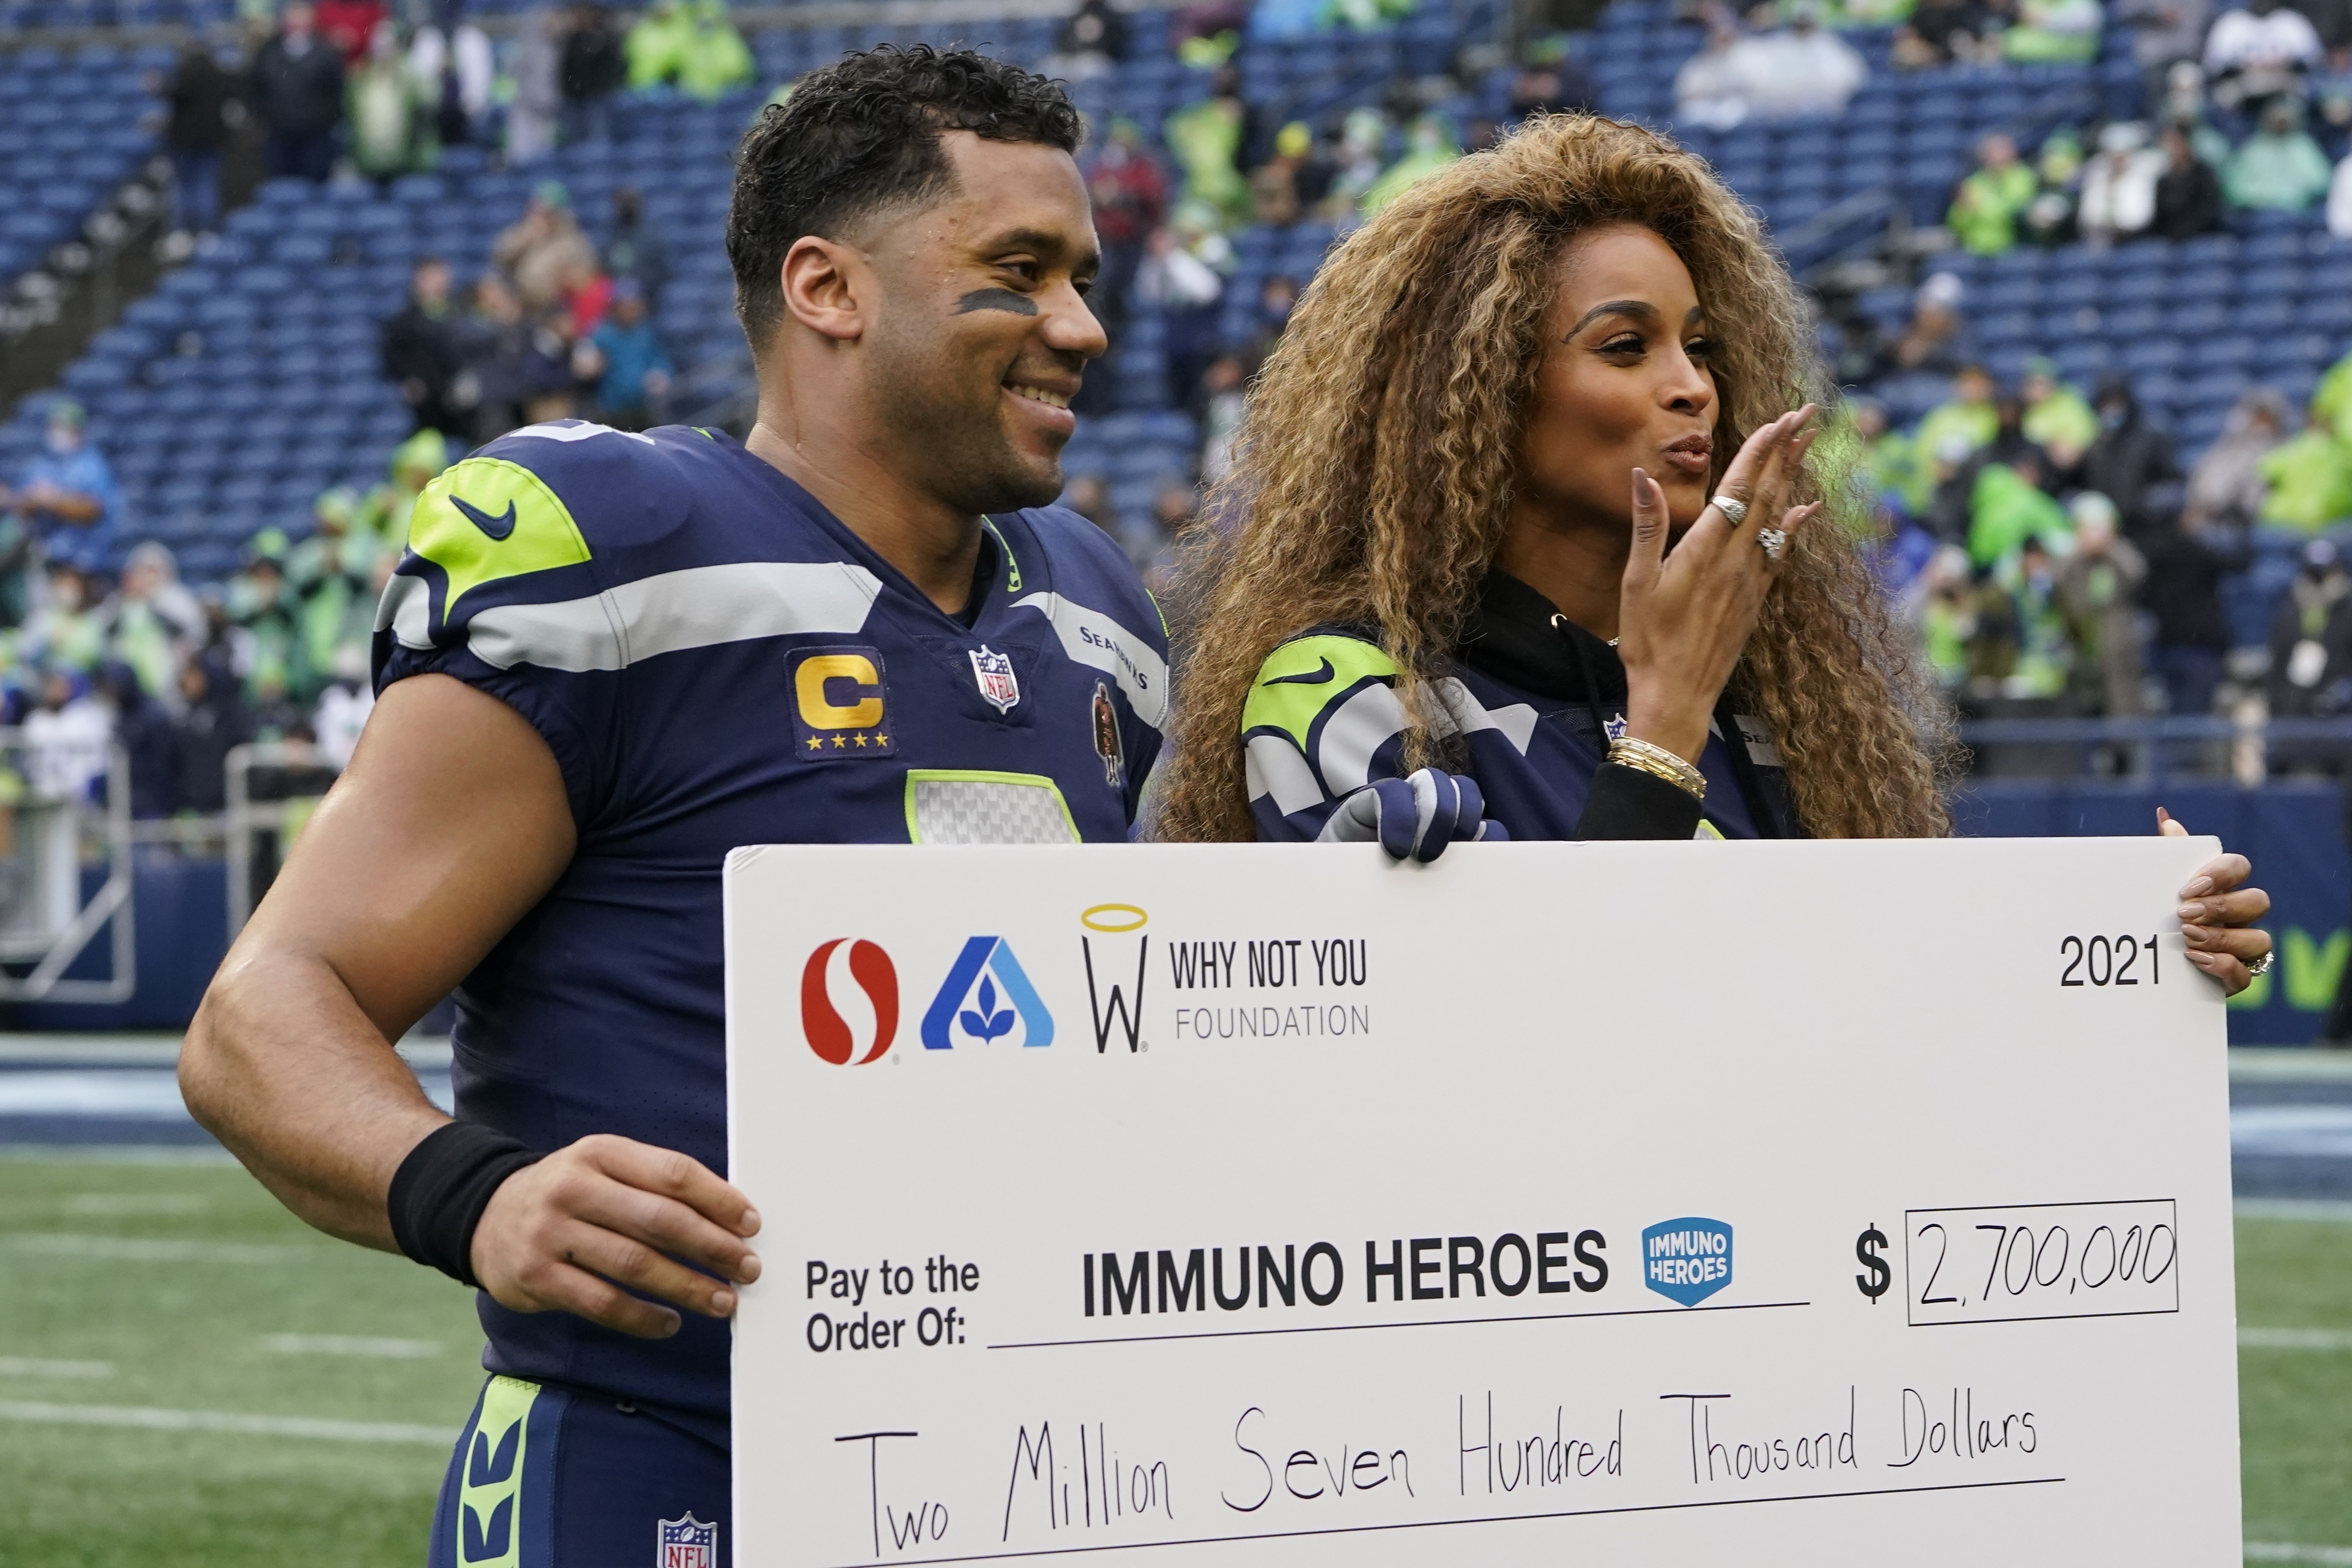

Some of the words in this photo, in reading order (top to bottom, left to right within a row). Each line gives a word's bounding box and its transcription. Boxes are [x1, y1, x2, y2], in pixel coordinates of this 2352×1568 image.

[795, 655, 884, 730] C
[985, 674, 1013, 699] NFL
[1170, 941, 1236, 989] WHY
[1249, 940, 1301, 988] NOT
[1312, 939, 1366, 986] YOU
[2061, 934, 2159, 986] 2021
[1176, 1005, 1369, 1039] FOUNDATION
[1649, 1231, 1727, 1257] IMMUNO
[1856, 1222, 1891, 1305] $
[1919, 1223, 2176, 1307] 2,700,000
[807, 1260, 869, 1306] Pay
[880, 1259, 913, 1295] to
[926, 1255, 979, 1293] the
[1084, 1242, 1344, 1317] IMMUNO
[1366, 1229, 1608, 1303] HEROES
[1650, 1257, 1727, 1285] HEROES
[806, 1311, 905, 1353] Order
[918, 1306, 965, 1347] Of:
[835, 1432, 948, 1558] Two
[1003, 1420, 1173, 1542] Million
[1221, 1407, 1414, 1512] Seven
[1460, 1390, 1623, 1496] Hundred
[1660, 1385, 1858, 1485] Thousand
[1887, 1387, 2036, 1468] Dollars
[668, 1546, 707, 1568] NFL
